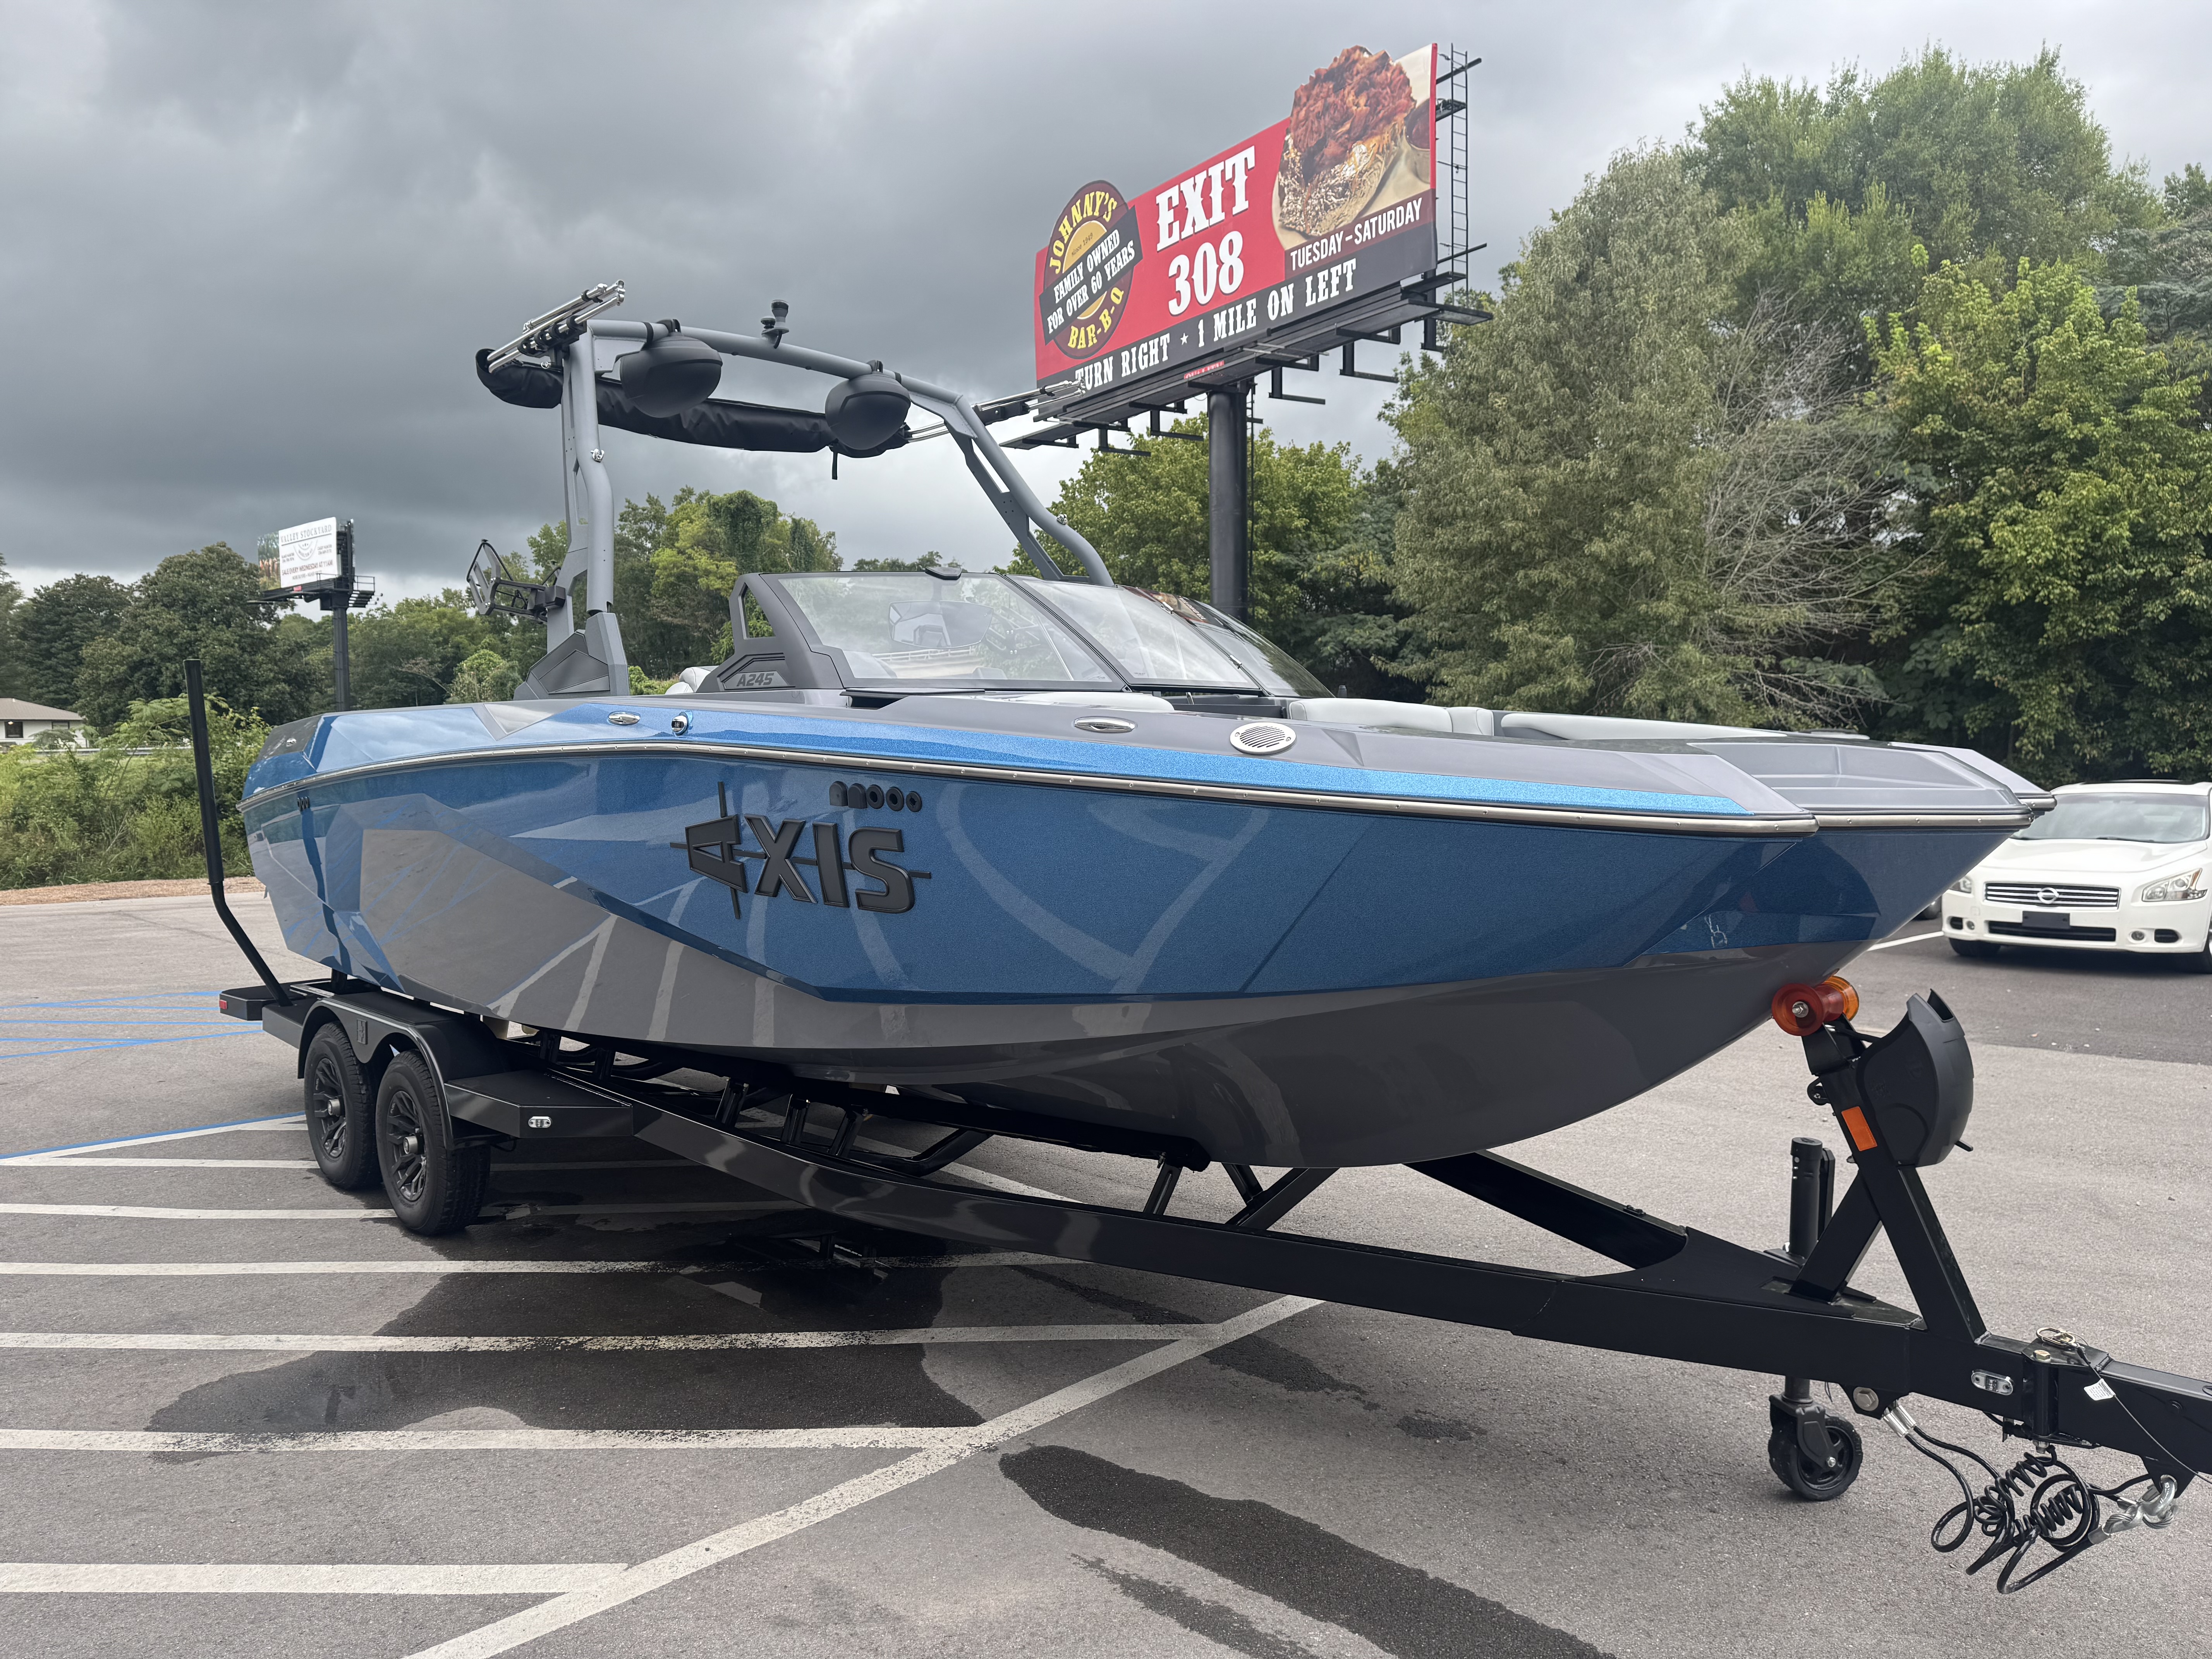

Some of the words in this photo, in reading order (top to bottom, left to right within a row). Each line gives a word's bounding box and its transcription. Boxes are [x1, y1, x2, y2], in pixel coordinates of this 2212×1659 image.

[1049, 191, 1117, 274] JOHNNY'S
[1156, 145, 1255, 252] EXIT
[1054, 262, 1084, 304] FAMILY
[1087, 229, 1120, 270] OWNED
[1083, 232, 1093, 246] 1949
[1168, 231, 1244, 315] 308
[1047, 309, 1064, 334] FOR
[1066, 285, 1089, 317] OVER
[1091, 271, 1102, 294] 60
[1104, 240, 1135, 281] YEARS
[1068, 287, 1124, 349] BAR-B-Q
[1075, 356, 1113, 390] TURN
[1121, 333, 1170, 377] RIGHT
[1198, 319, 1204, 347] 1
[1213, 298, 1256, 342] MILE
[1267, 283, 1294, 320] ON
[1305, 258, 1356, 307] LEFT
[281, 532, 298, 543] VALLEY
[301, 525, 331, 538] STOCKYARD
[299, 562, 318, 571] WEDNESDAY
[737, 673, 774, 687] A245
[685, 814, 915, 914] AXIS
